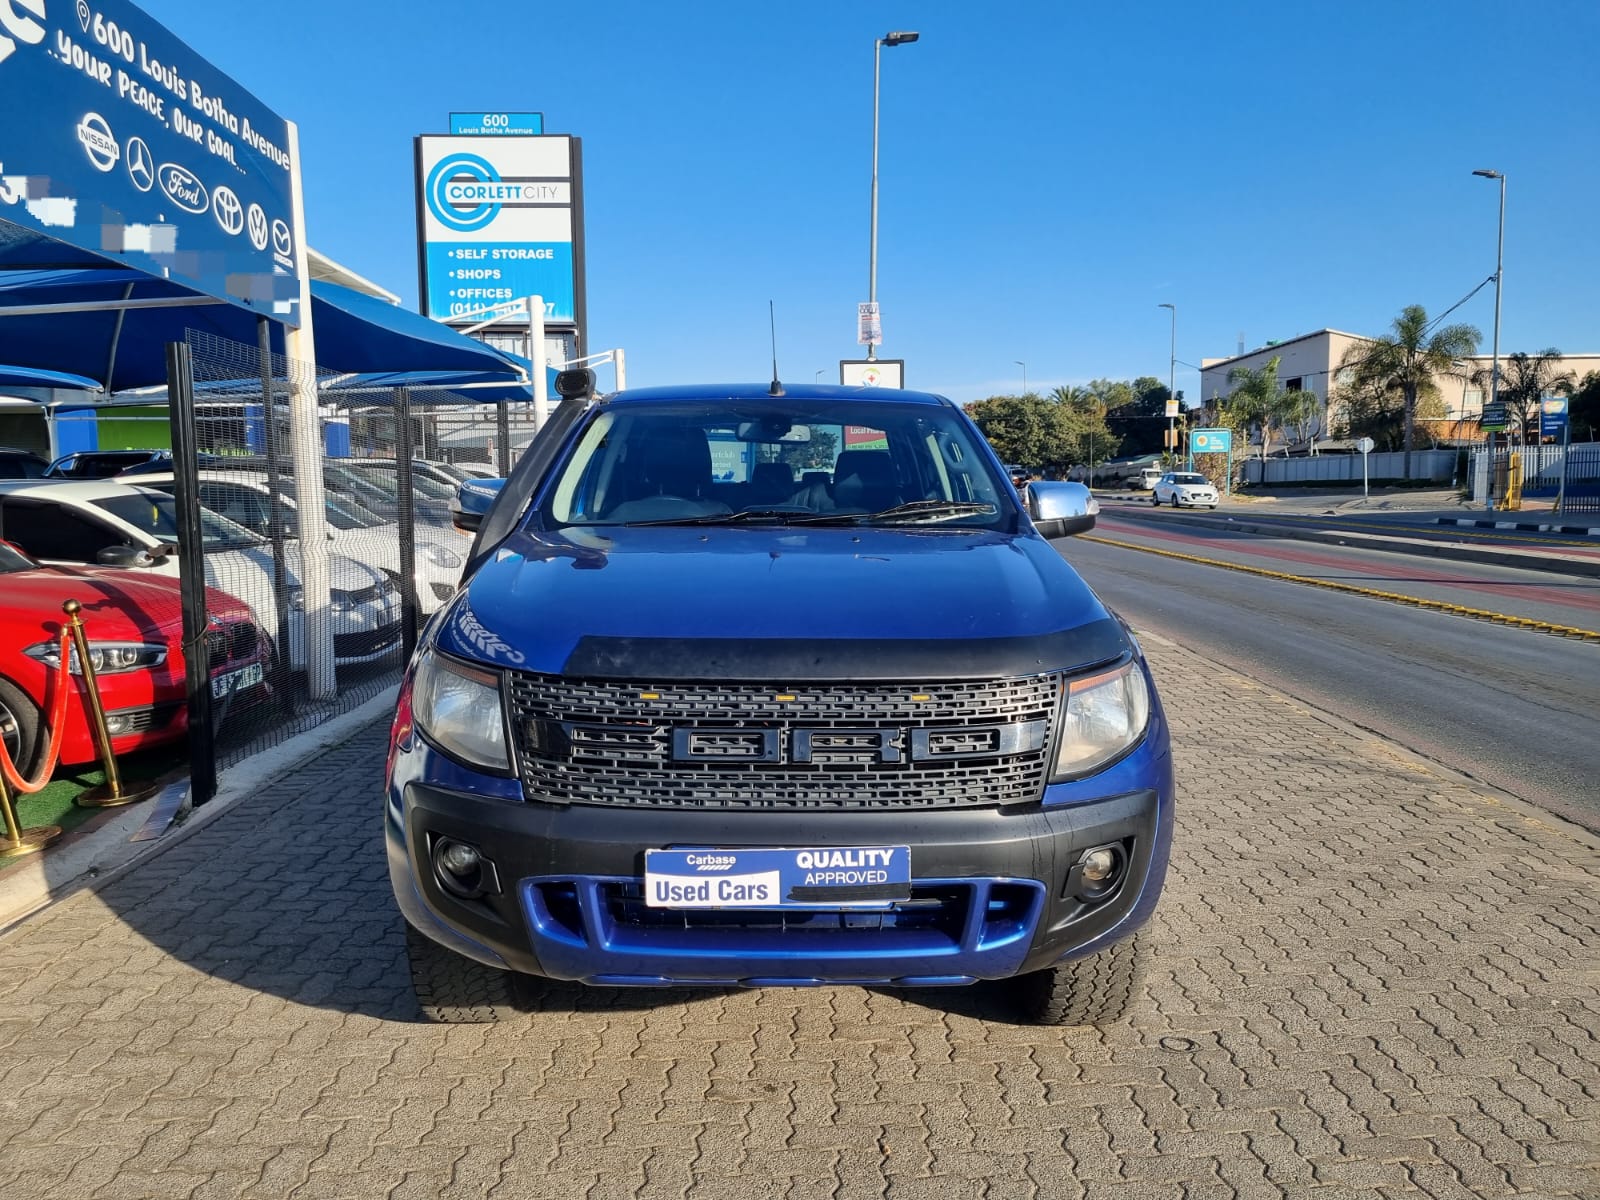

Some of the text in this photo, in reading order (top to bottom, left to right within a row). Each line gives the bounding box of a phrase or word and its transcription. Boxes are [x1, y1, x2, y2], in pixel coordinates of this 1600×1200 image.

[93, 12, 290, 170] 600 Louis Botha Avenue
[173, 107, 203, 145] OUR
[482, 113, 508, 127] 600
[80, 128, 118, 156] NISSAN
[168, 169, 200, 206] Ford
[450, 185, 557, 199] CORLETT CITY
[456, 249, 553, 259] SELF STORAGE
[457, 269, 501, 279] SHOPS
[457, 288, 512, 298] OFFICES
[687, 849, 894, 869] Carbase QUALITY
[805, 871, 888, 885] APPROVED
[656, 879, 769, 901] Used Cars
